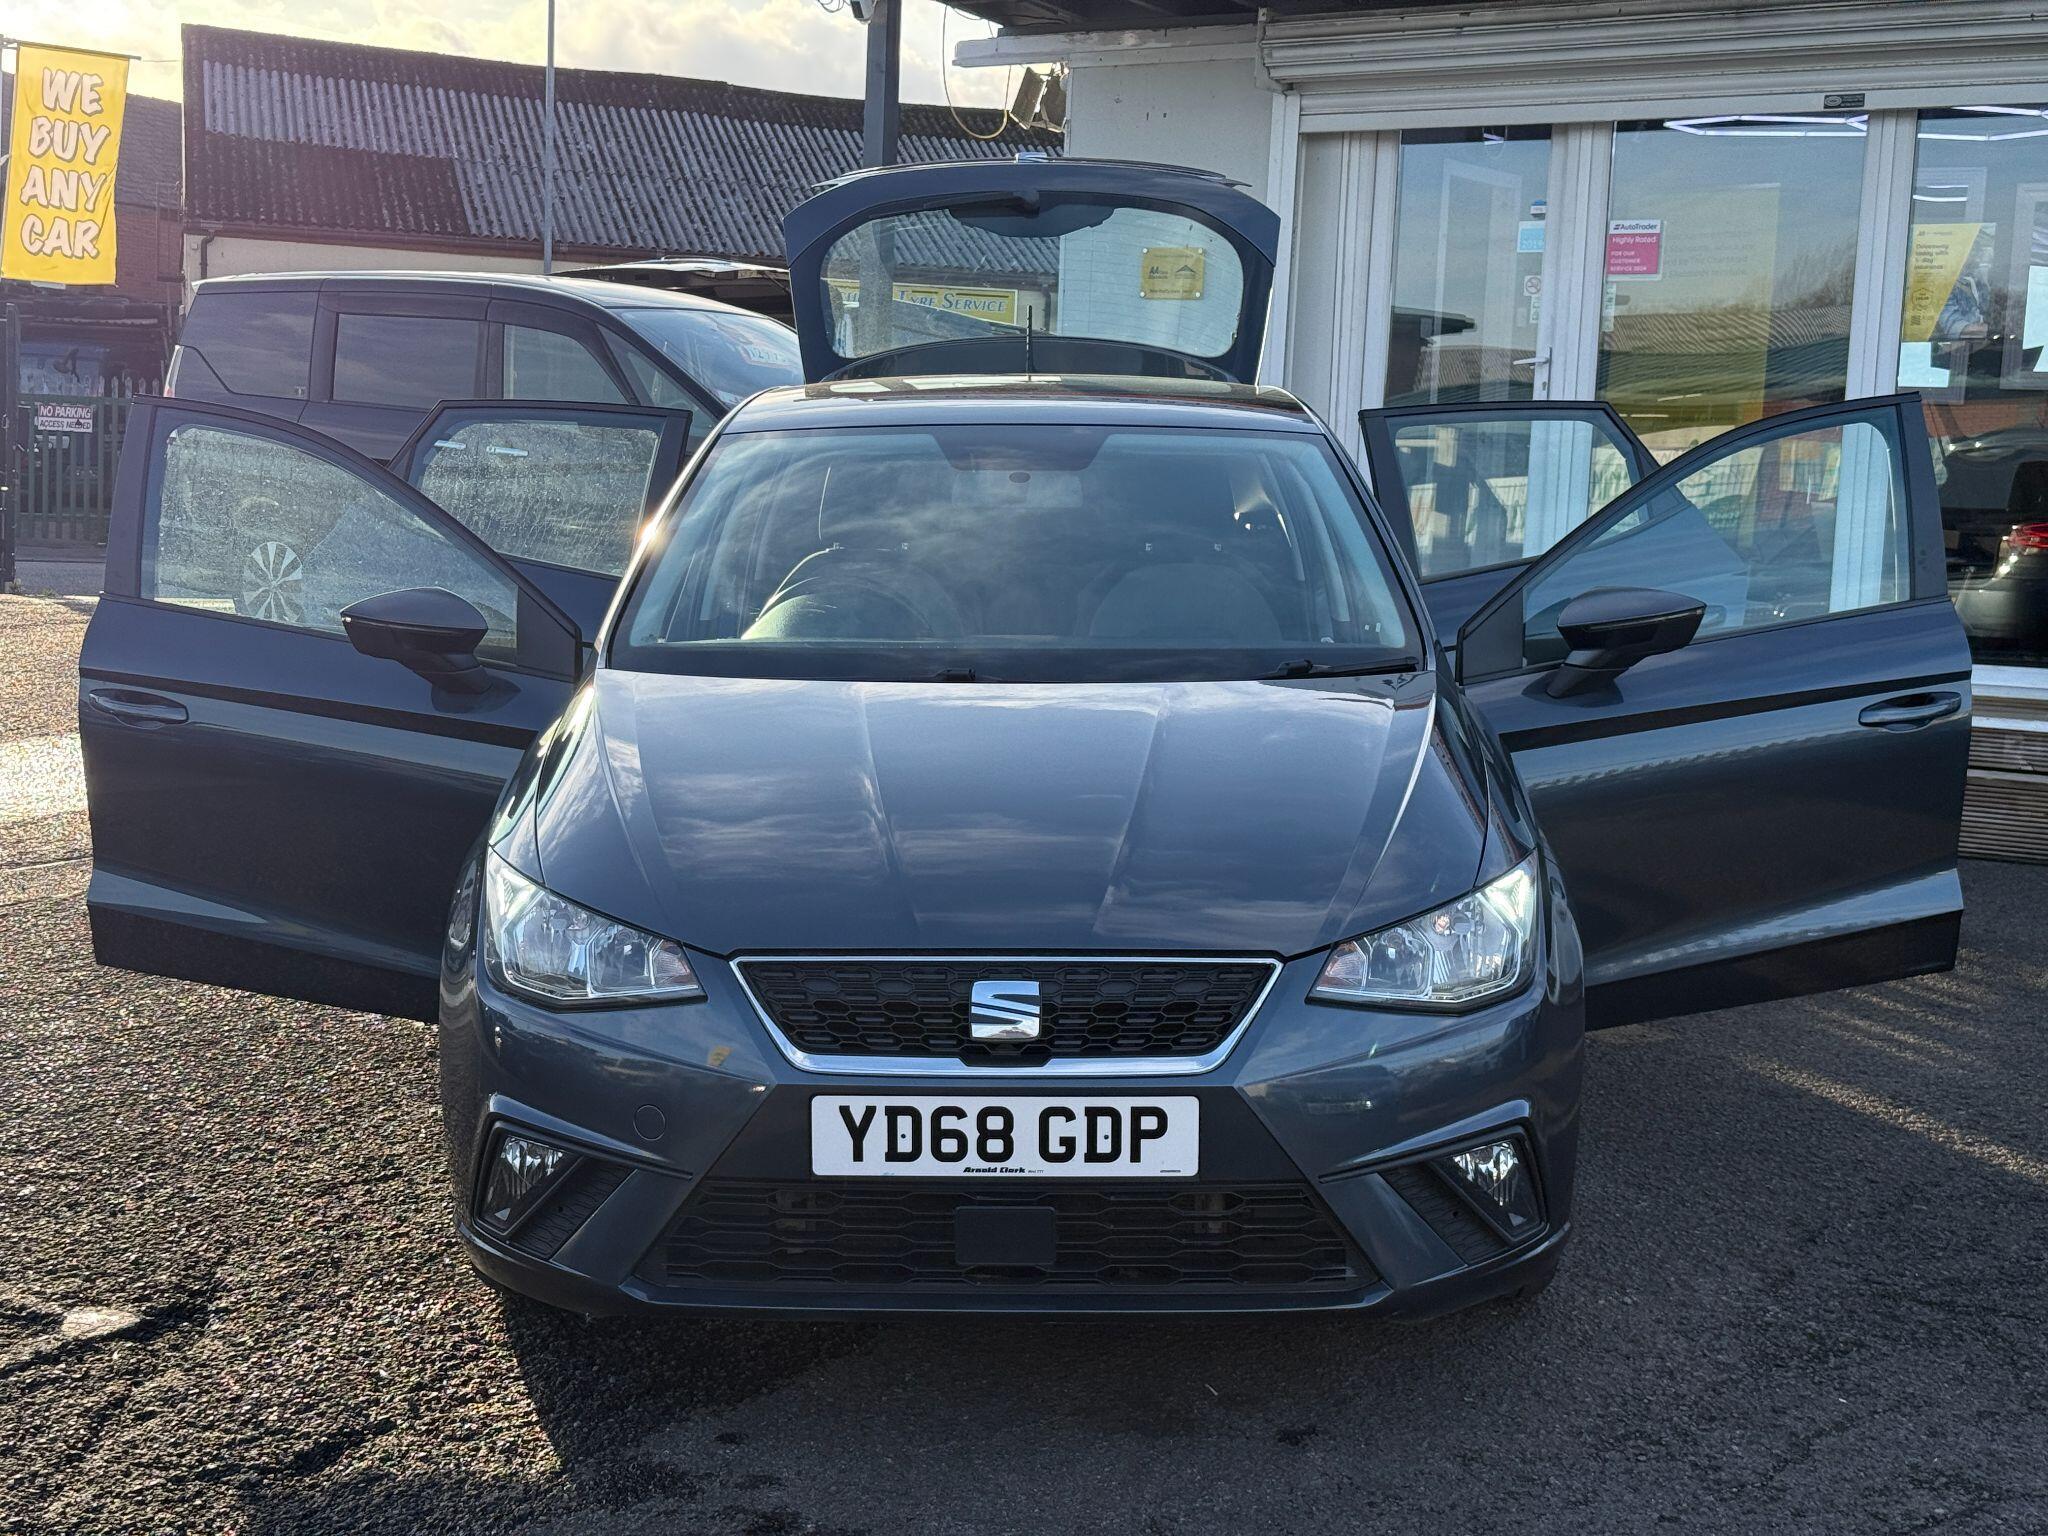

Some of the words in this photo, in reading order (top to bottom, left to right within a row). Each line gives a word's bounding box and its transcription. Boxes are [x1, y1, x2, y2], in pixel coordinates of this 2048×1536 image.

[42, 67, 104, 116] WE
[28, 116, 111, 165] BUY
[20, 164, 107, 213] ANY
[20, 213, 101, 259] CAR
[1612, 236, 1635, 244] Highly
[1635, 235, 1657, 243] Rated
[40, 405, 54, 416] NO
[55, 406, 91, 418] PARKING
[40, 420, 65, 429] ACCESS
[838, 1105, 1015, 1163] YD68
[1038, 1105, 1169, 1163] GDP
